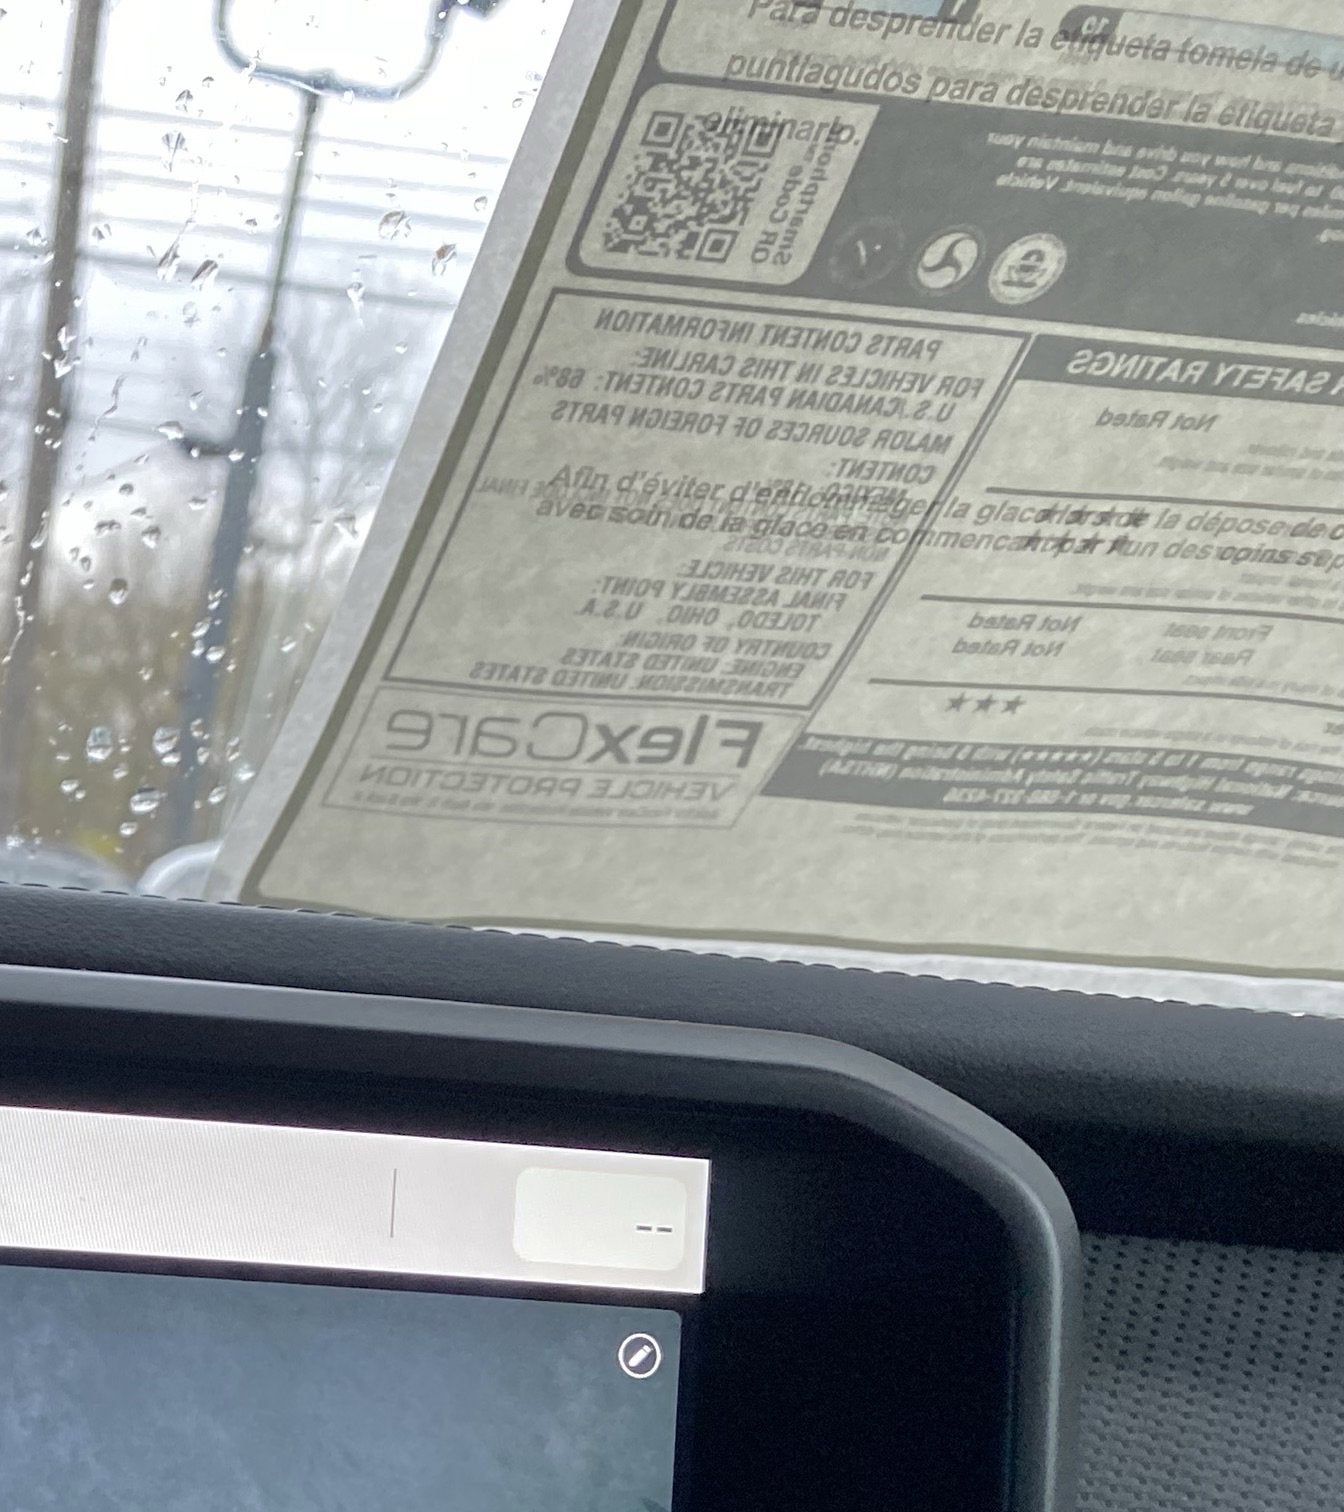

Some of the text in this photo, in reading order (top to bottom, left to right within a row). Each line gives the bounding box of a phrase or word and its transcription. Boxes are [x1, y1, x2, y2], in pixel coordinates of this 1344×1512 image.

[829, 3, 1011, 45] desprender
[1014, 18, 1044, 48] la
[725, 52, 1337, 138] puntiagudos para desprender la etiqueta
